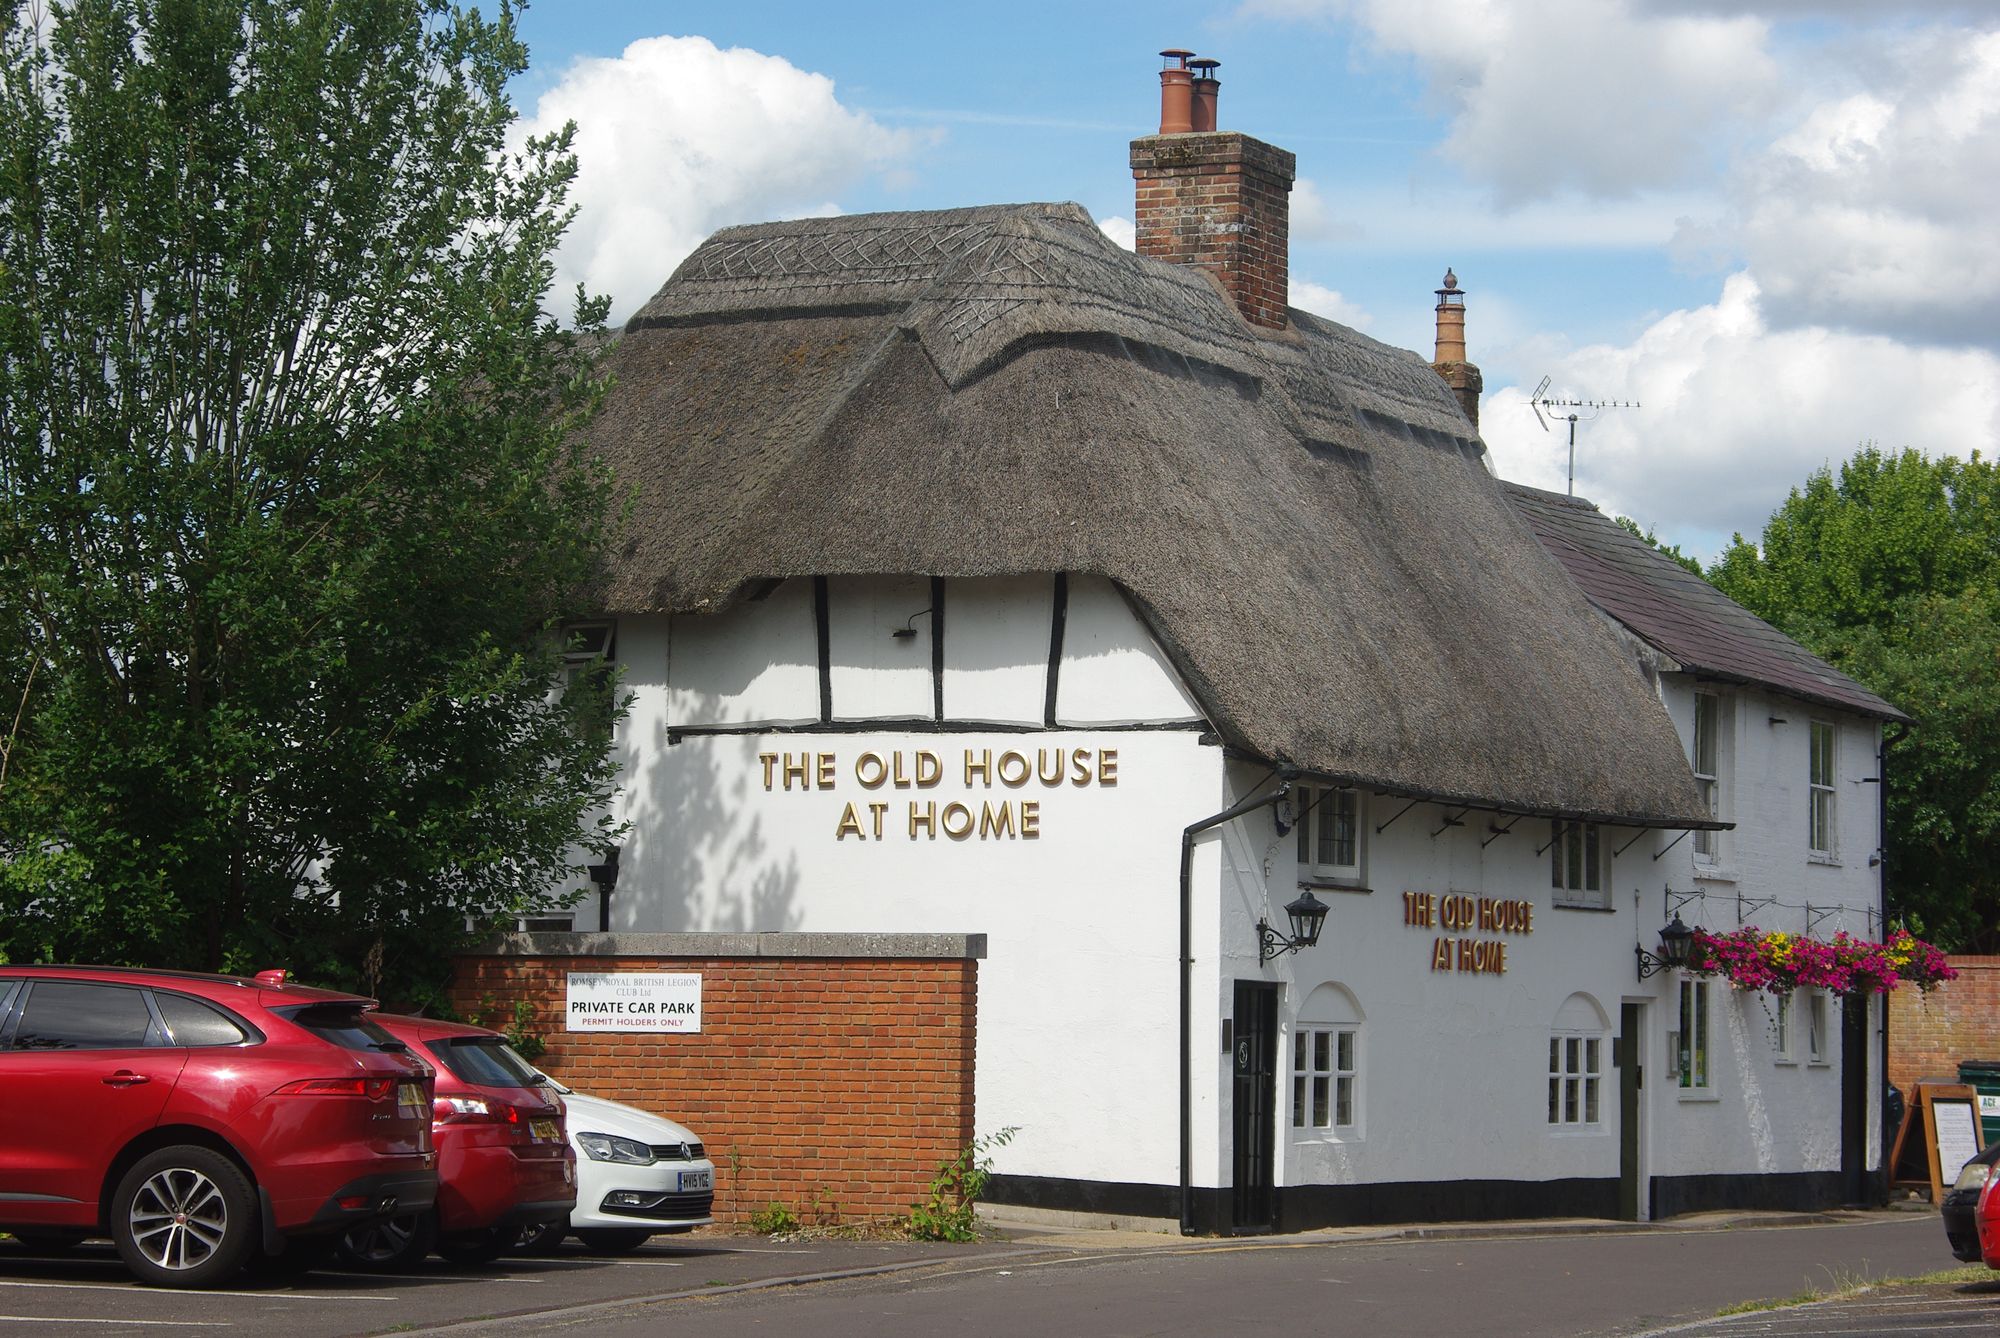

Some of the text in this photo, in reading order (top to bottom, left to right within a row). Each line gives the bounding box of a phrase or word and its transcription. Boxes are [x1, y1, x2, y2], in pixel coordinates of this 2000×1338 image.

[759, 747, 1118, 790] THE OLD HOUSE
[836, 800, 1040, 841] AT HOME
[1403, 891, 1535, 934] THE OLD HOUSE
[1431, 937, 1508, 976] AT HOME
[571, 977, 698, 987] ROMSEY ROYAL BRITISH LEGION
[616, 988, 638, 997] CLUB
[571, 1002, 695, 1014] PRIVATE CAR PARK
[582, 1018, 684, 1027] PERMIT HOLDERS ONLY
